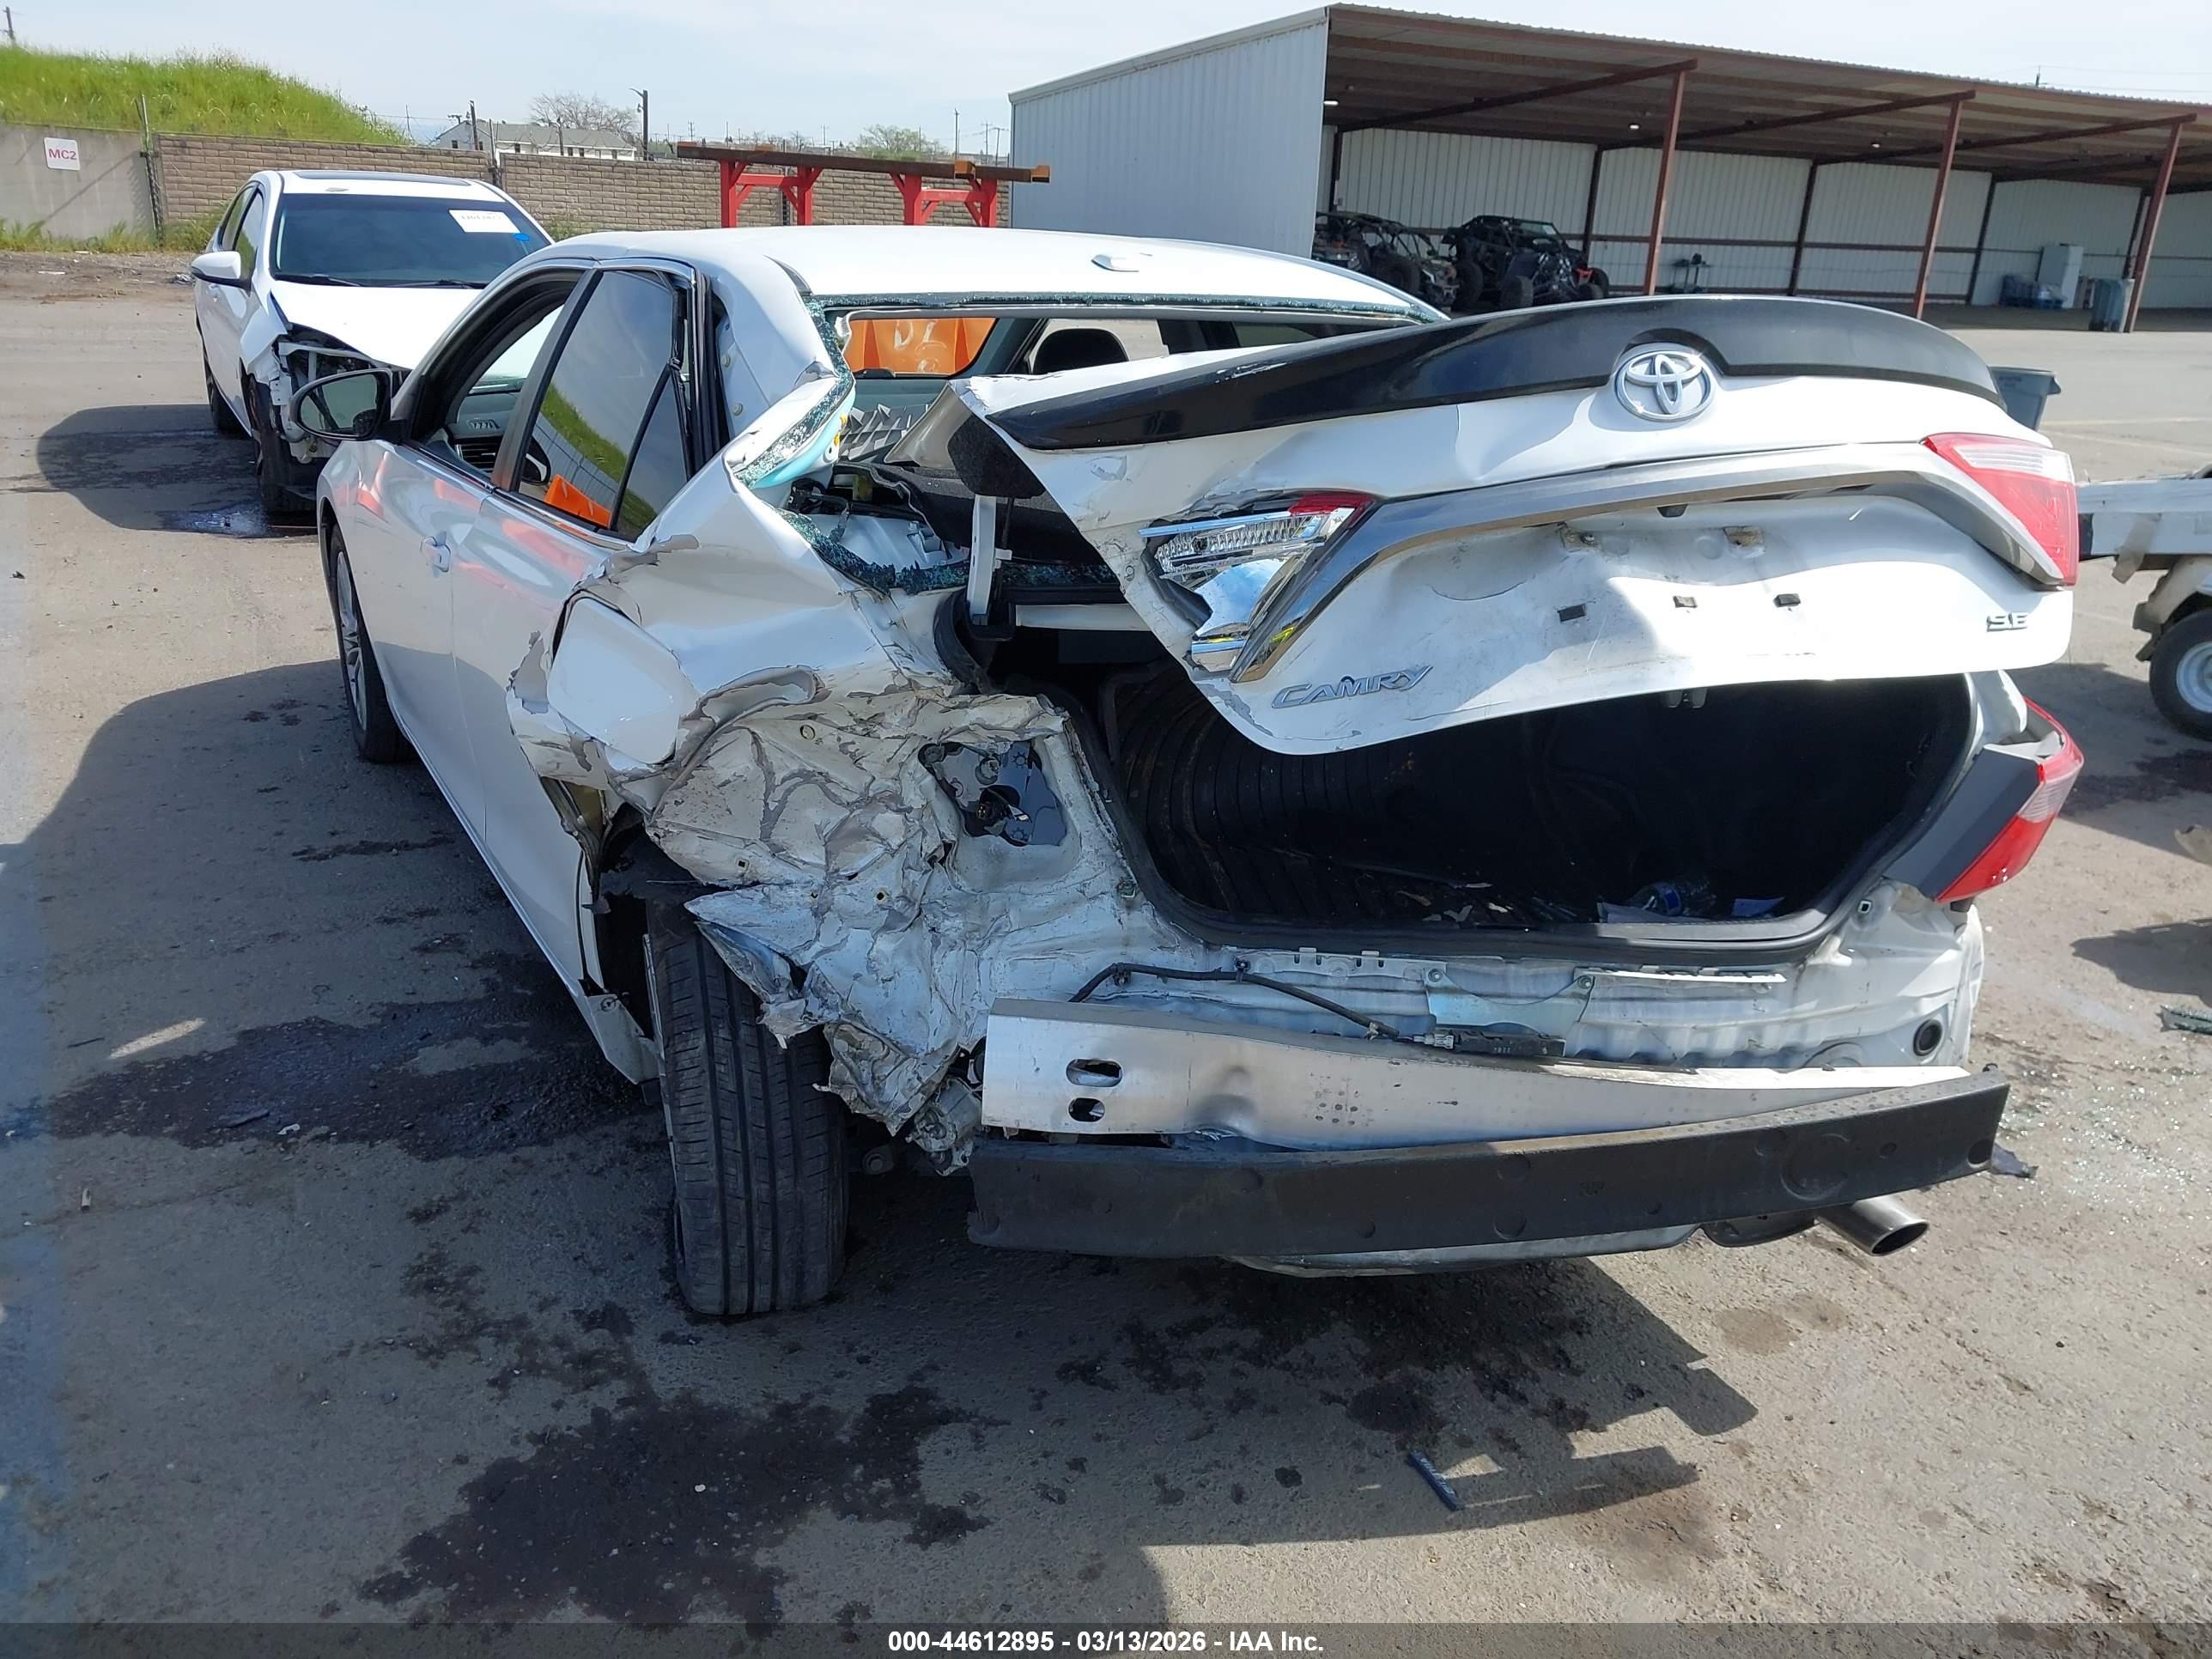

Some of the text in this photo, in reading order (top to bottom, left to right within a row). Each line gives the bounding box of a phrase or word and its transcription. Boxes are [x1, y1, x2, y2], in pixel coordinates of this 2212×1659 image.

[48, 149, 77, 161] MC2
[1985, 611, 2028, 632] SE
[1271, 665, 1433, 708] CAMRY
